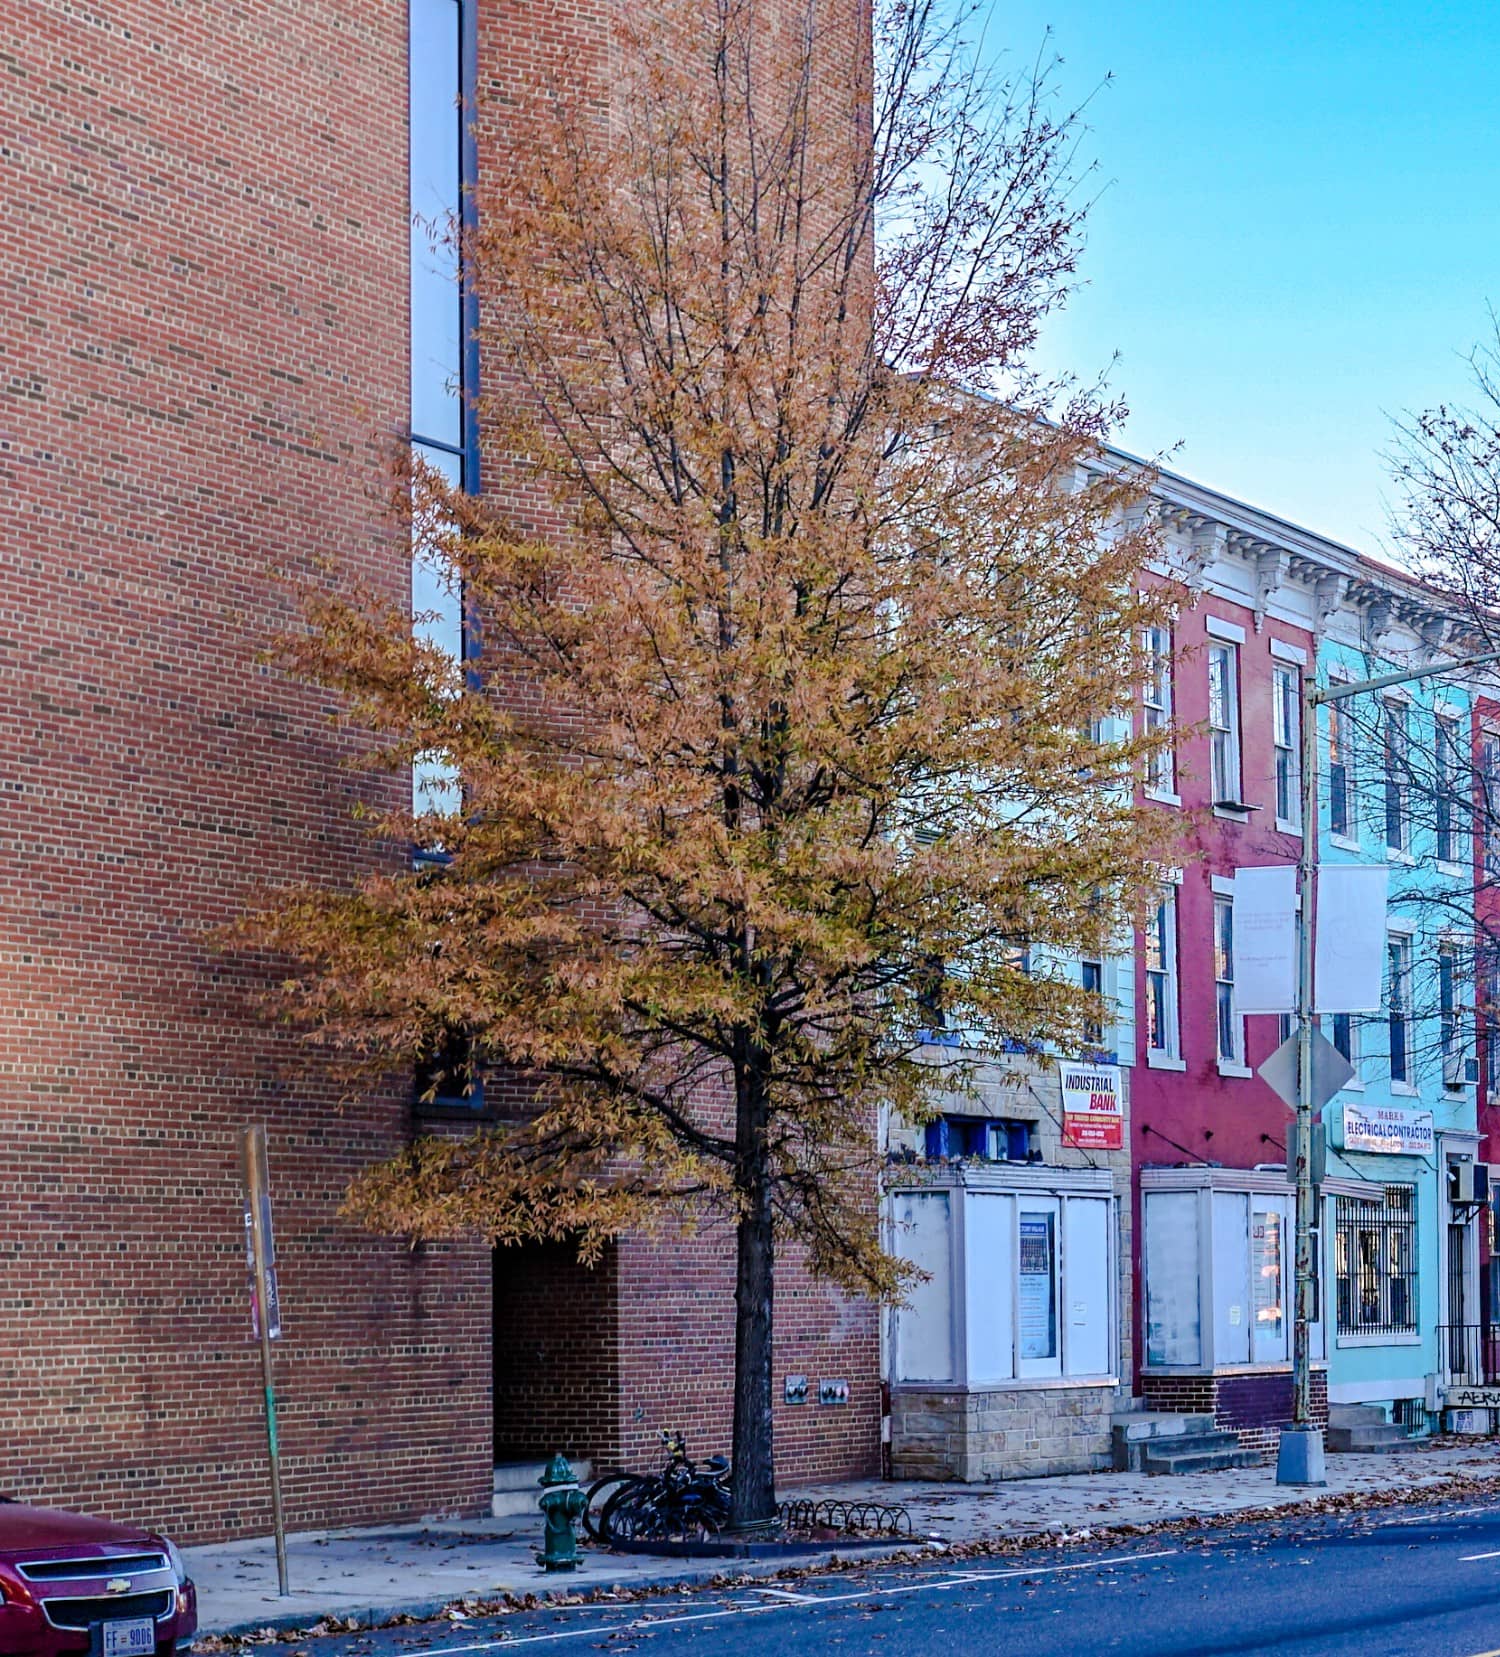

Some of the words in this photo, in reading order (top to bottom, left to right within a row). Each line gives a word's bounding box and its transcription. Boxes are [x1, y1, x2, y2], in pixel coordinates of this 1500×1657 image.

[1065, 1073, 1114, 1092] INDUSTRIAL
[1089, 1093, 1117, 1111] BANK
[1348, 1121, 1386, 1137] ELECTRICAL
[1387, 1124, 1432, 1140] CONTRACTOR
[105, 1630, 118, 1649] FF
